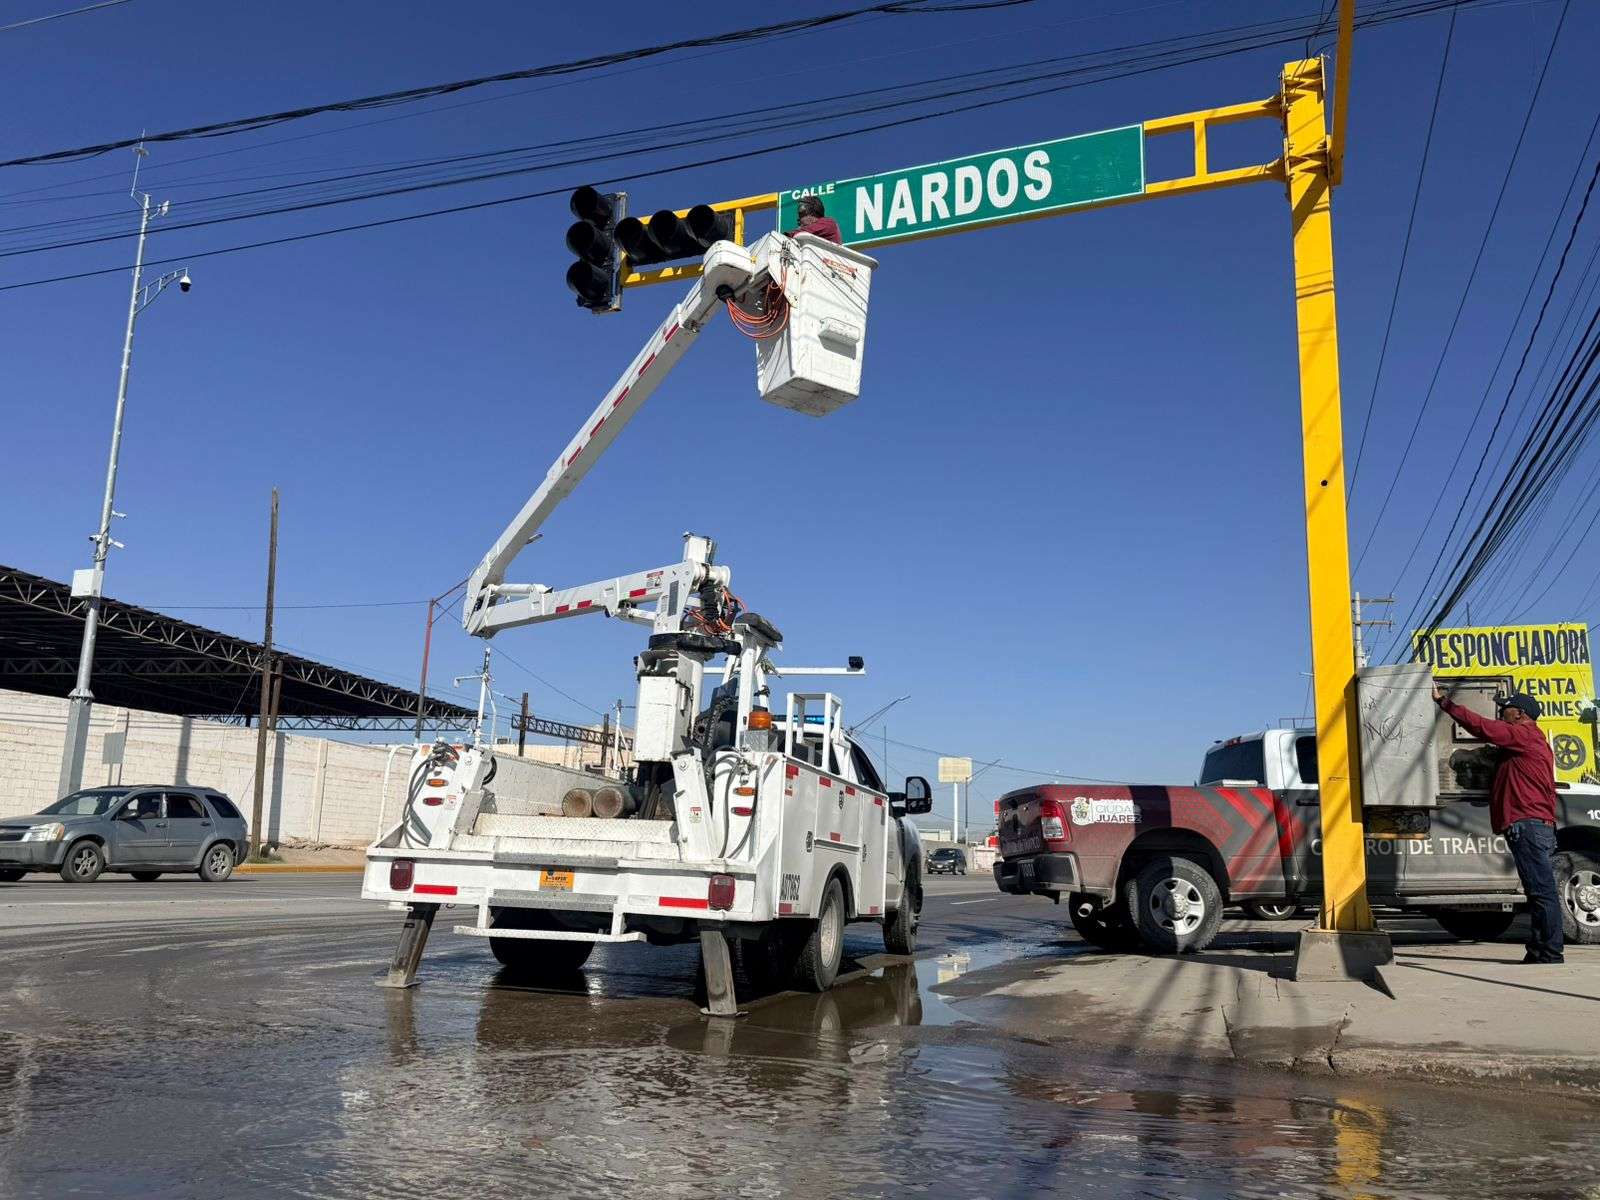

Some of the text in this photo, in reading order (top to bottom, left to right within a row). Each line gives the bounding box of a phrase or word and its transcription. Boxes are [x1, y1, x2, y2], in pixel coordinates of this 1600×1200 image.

[791, 183, 835, 200] CALLE
[855, 150, 1052, 234] NARDOS
[1409, 837, 1434, 854] DE
